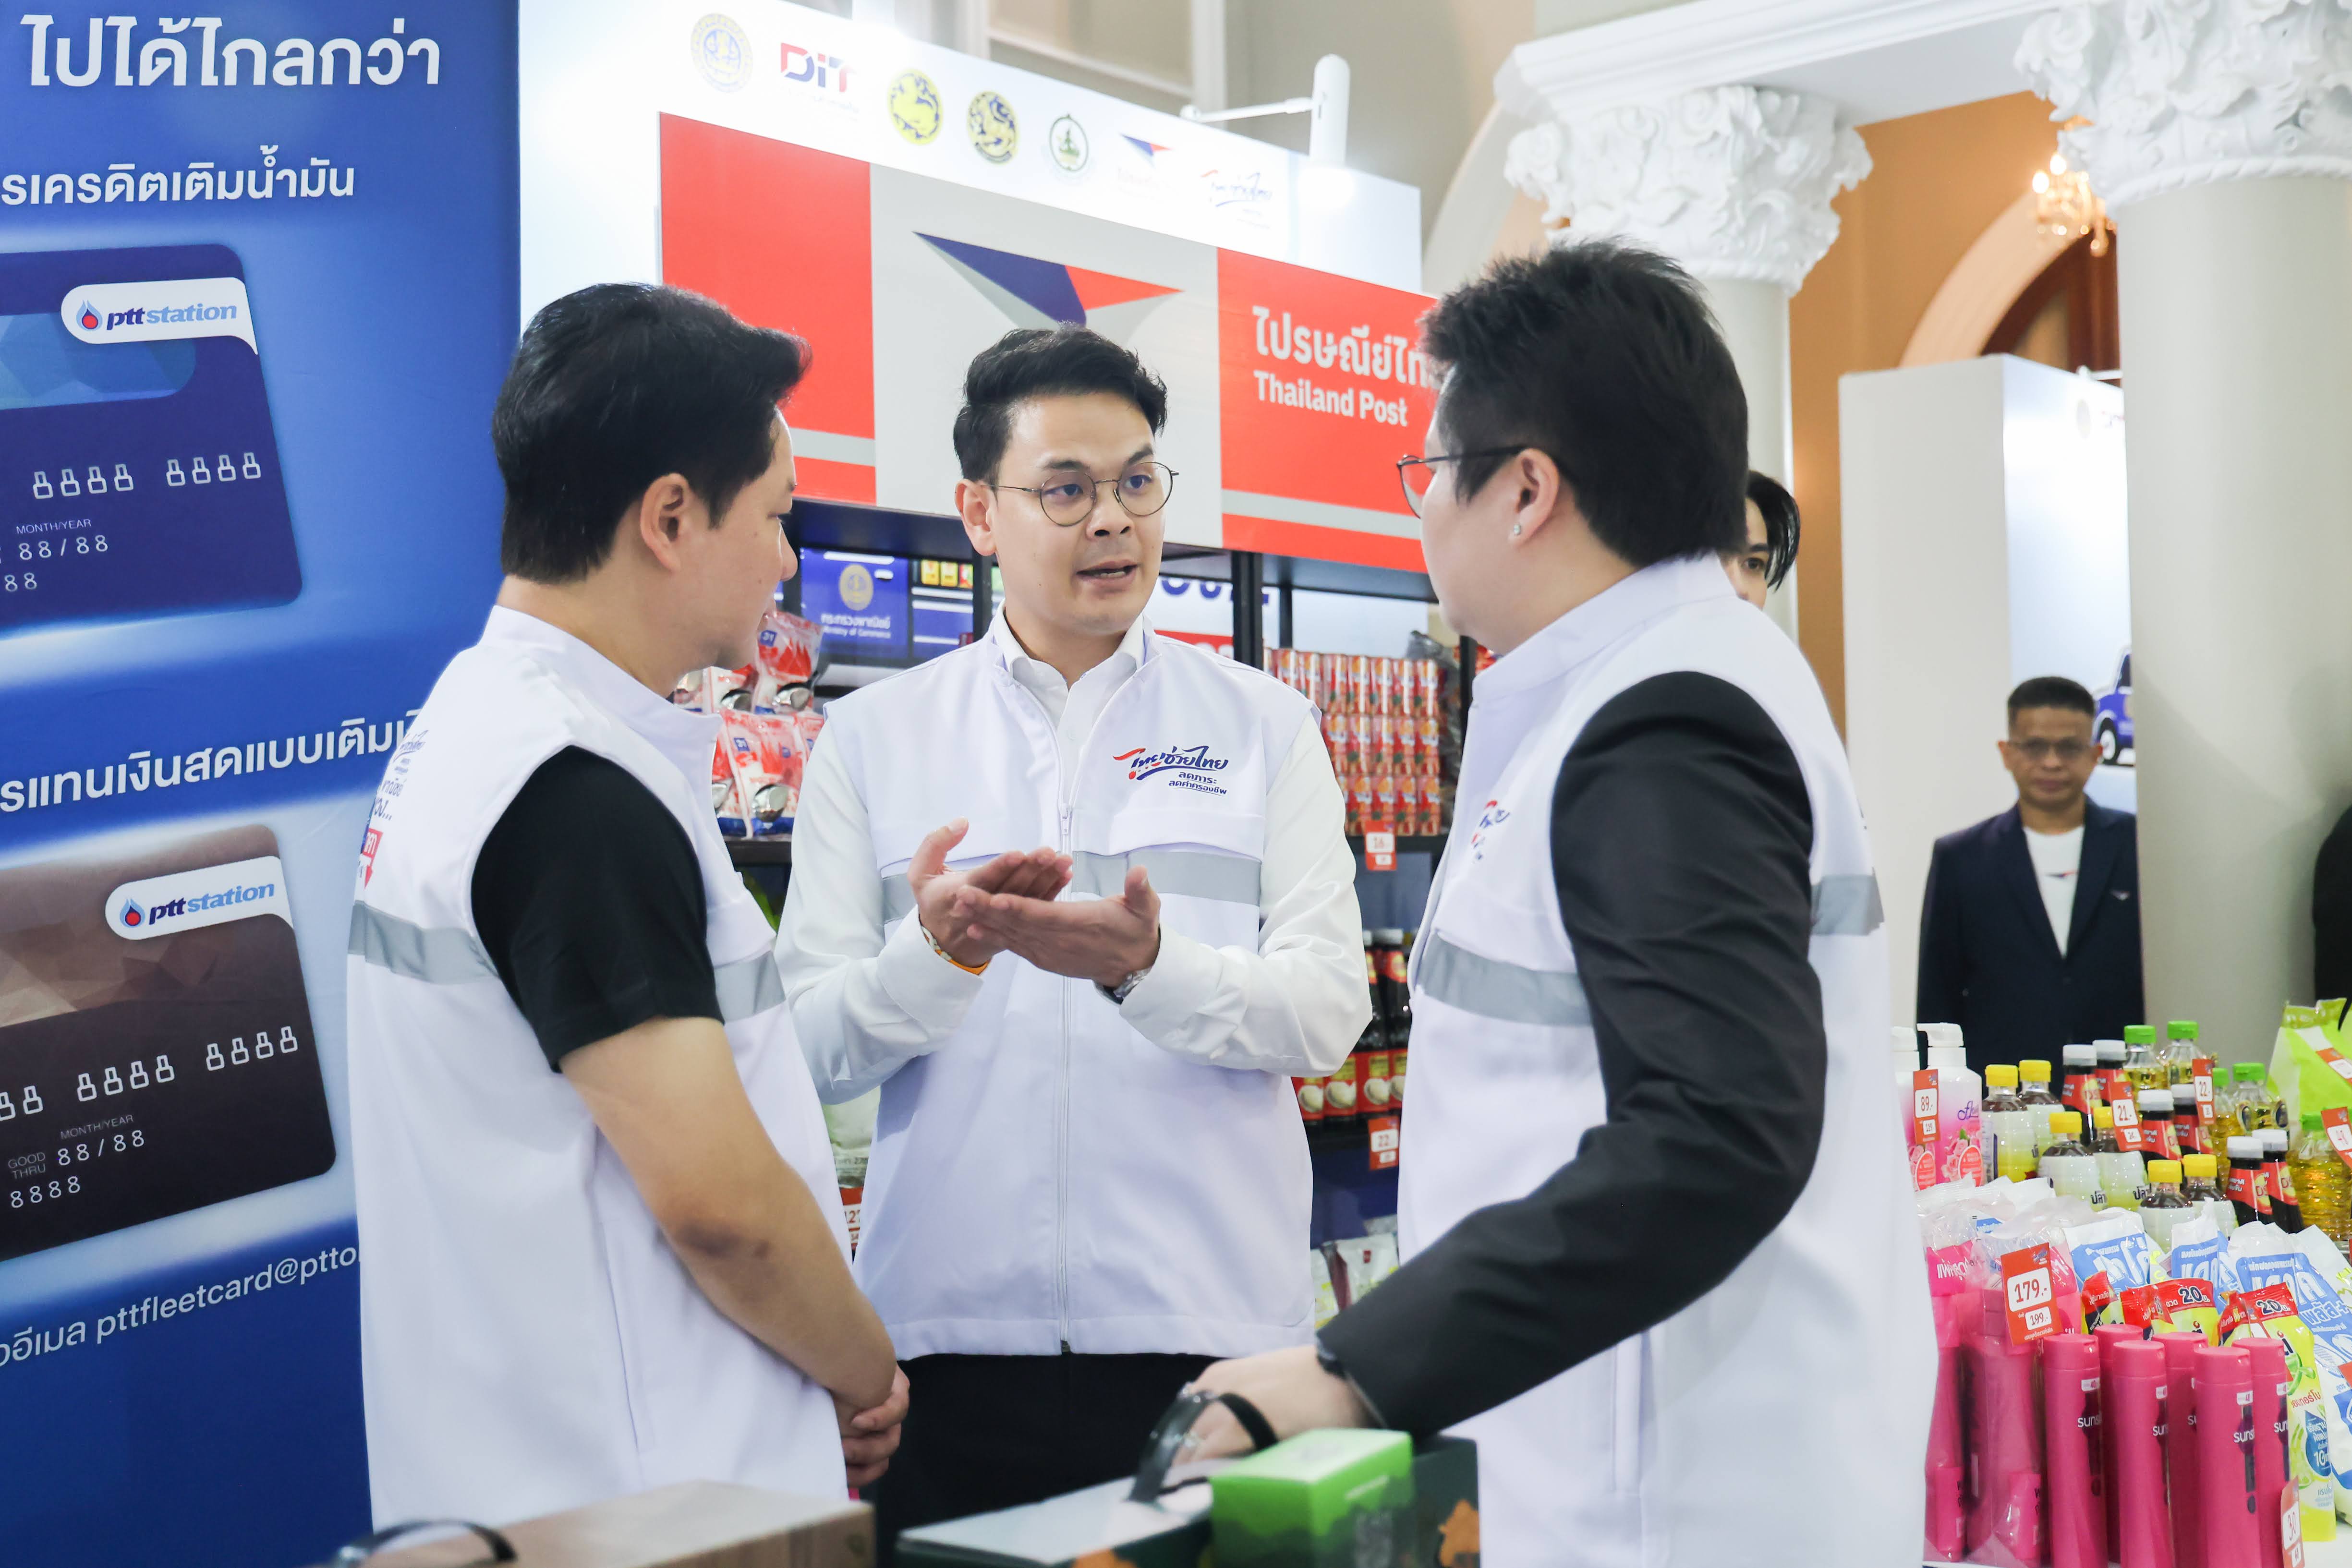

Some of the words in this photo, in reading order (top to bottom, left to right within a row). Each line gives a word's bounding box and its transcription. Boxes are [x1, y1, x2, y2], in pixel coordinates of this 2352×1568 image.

[21, 14, 440, 86] ไปได้ไกลกว่า
[1252, 305, 1431, 390] ไปรษณีย์ไท
[1253, 370, 1354, 417] Thailand
[1359, 389, 1408, 427] Post
[16, 519, 92, 534] MONTH/YEAR
[1168, 779, 1227, 795] ลดค่าครองชีพ
[1178, 771, 1217, 784] ลดภาระ
[60, 1114, 134, 1140] MONTH/YEAR
[8, 1152, 46, 1169] GOOD
[12, 1163, 46, 1180] THRU
[97, 1247, 361, 1345] pttfleetcard@ptto
